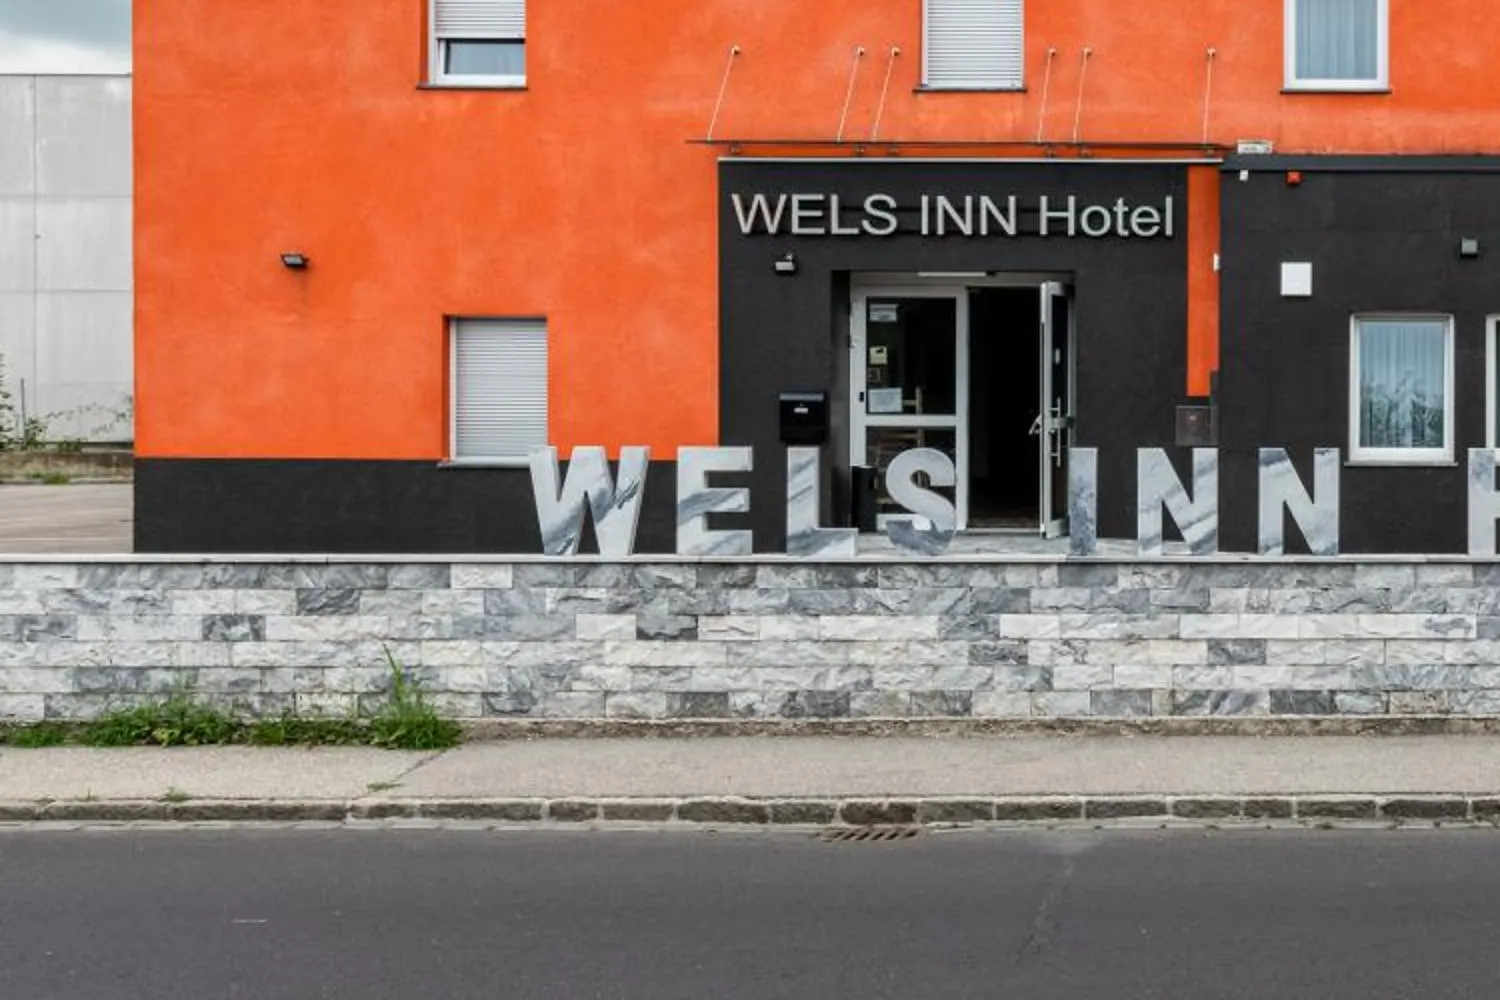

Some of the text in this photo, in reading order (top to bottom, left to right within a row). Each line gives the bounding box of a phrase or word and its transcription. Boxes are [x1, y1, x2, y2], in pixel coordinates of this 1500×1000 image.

[731, 193, 1174, 237] WELS INN Hotel
[528, 446, 957, 556] WELS
[1069, 446, 1341, 556] INN
